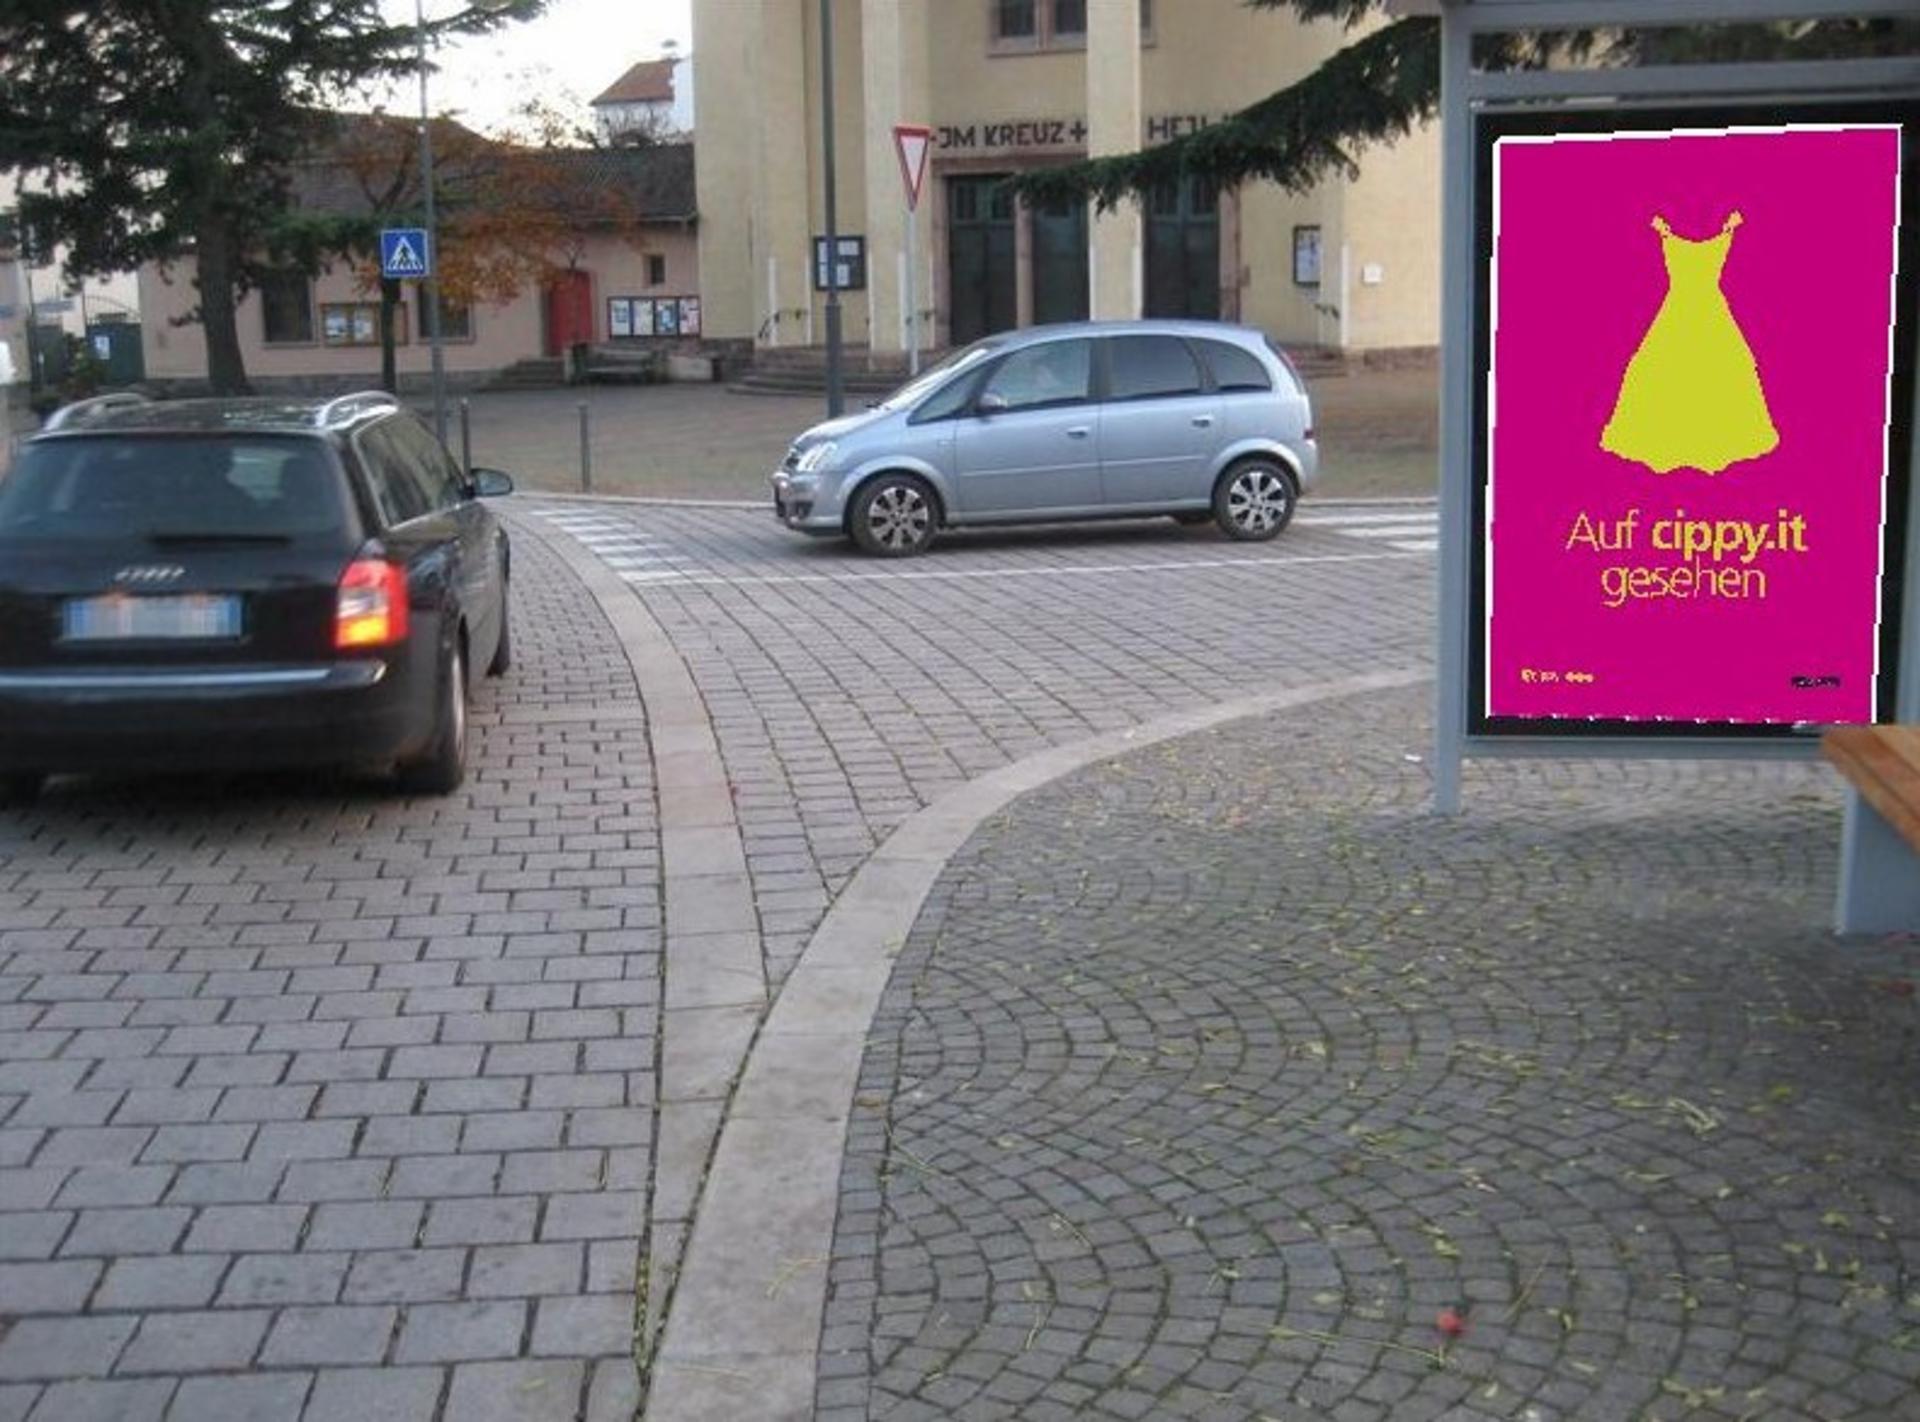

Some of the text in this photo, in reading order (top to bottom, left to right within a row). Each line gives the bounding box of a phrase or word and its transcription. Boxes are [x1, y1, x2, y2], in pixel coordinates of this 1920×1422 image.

[984, 119, 1065, 147] KREUZ
[1565, 508, 1809, 563] Auf cippy.it
[1600, 555, 1767, 608] gesehen
